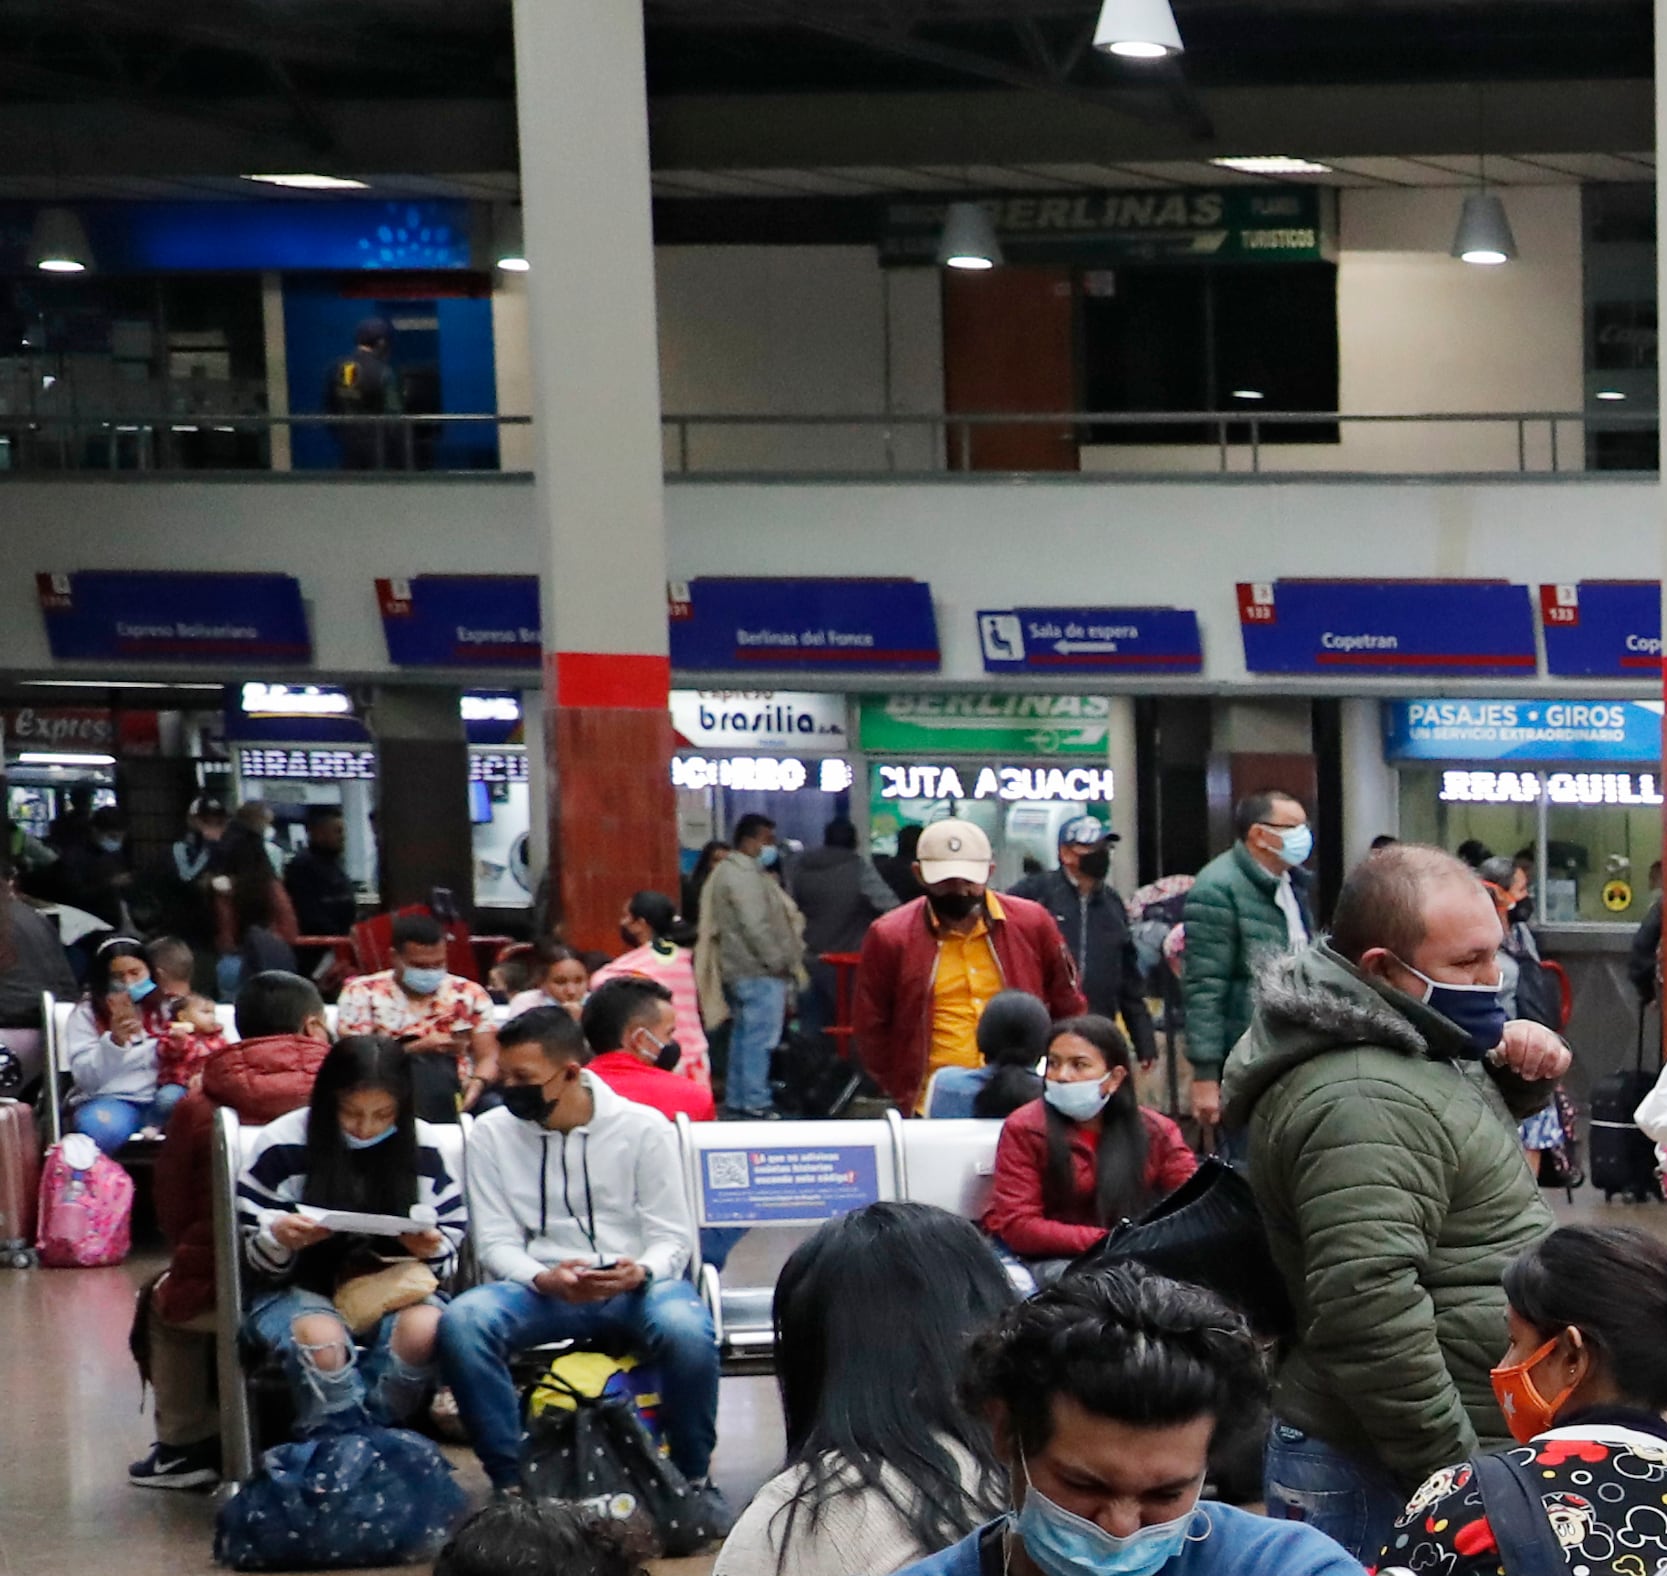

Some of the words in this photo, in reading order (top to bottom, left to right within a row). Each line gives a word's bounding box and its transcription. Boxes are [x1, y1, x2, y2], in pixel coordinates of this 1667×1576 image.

[988, 193, 1225, 230] BERLINAS
[519, 626, 542, 642] Bra
[737, 629, 798, 646] Berlinas
[801, 630, 825, 646] del
[828, 629, 873, 646] Fonce
[1030, 623, 1063, 640] Sala
[1065, 623, 1086, 640] de
[1088, 625, 1138, 643] espera
[1321, 632, 1398, 651] Copetran
[1626, 634, 1662, 654] Cop
[700, 706, 814, 732] brasilia
[1408, 704, 1518, 727] PASAJES
[1546, 705, 1625, 728] GIROS
[1409, 727, 1431, 741] UN
[1433, 727, 1497, 742] SERVICIO
[1500, 729, 1625, 742] EXTRAORDINARIO
